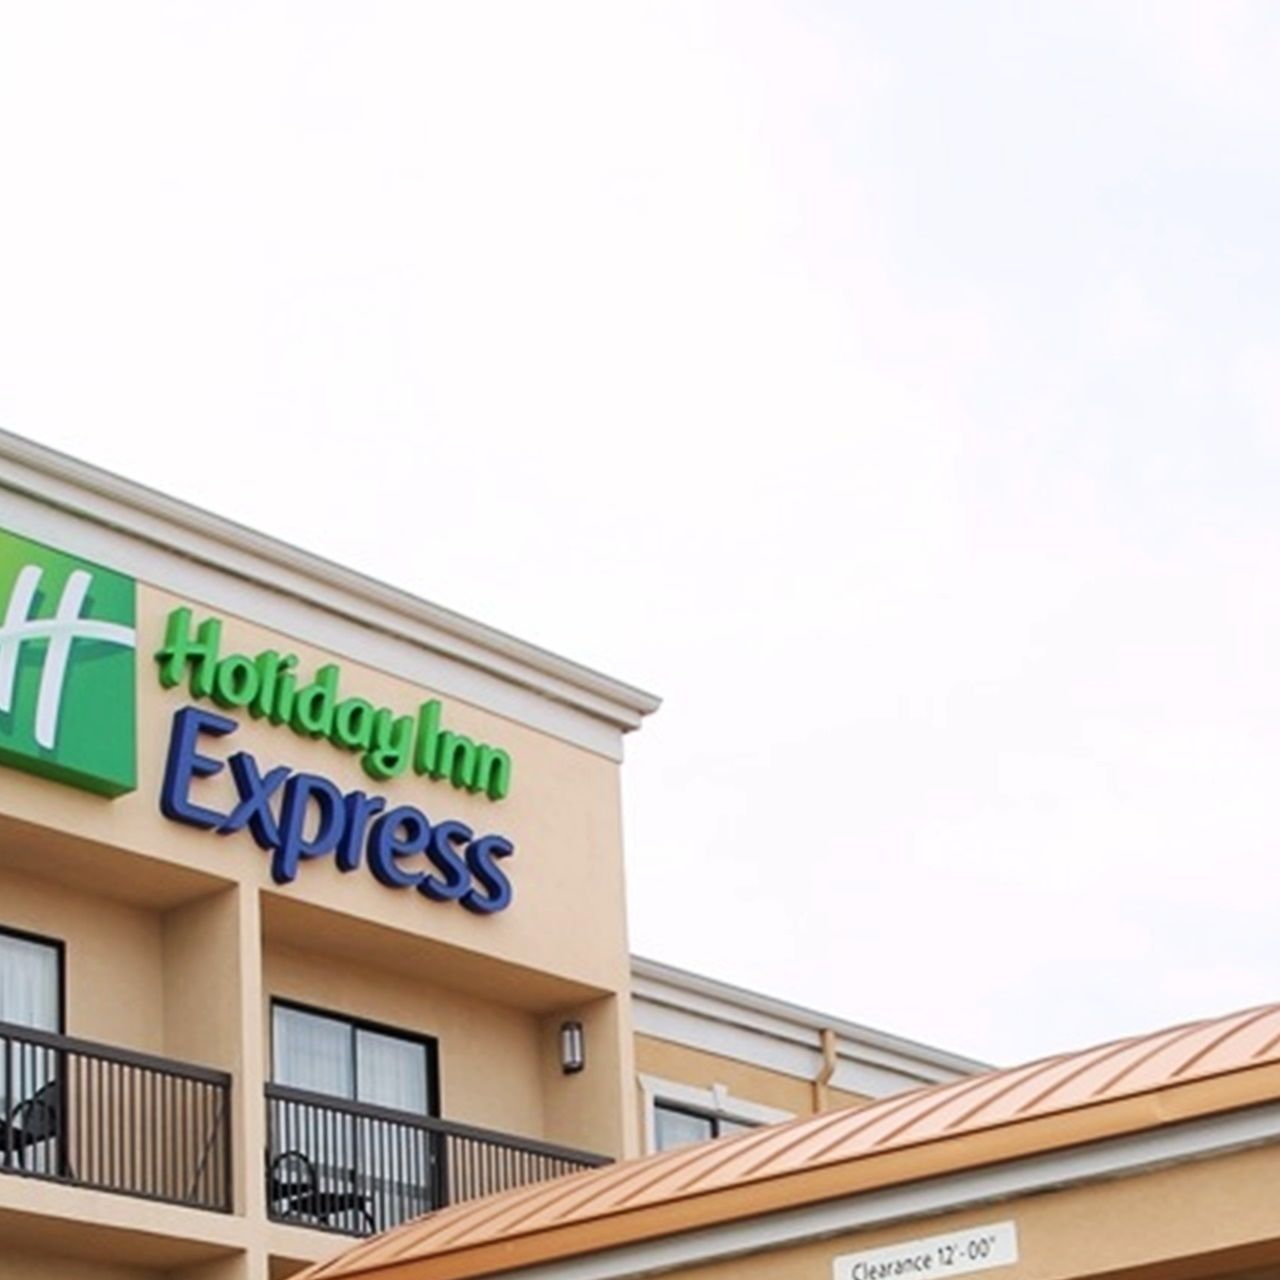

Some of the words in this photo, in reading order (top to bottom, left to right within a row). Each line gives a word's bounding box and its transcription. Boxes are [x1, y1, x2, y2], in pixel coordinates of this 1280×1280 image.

[154, 606, 417, 781] Holiday
[414, 699, 513, 801] Inn
[158, 705, 516, 915] Express
